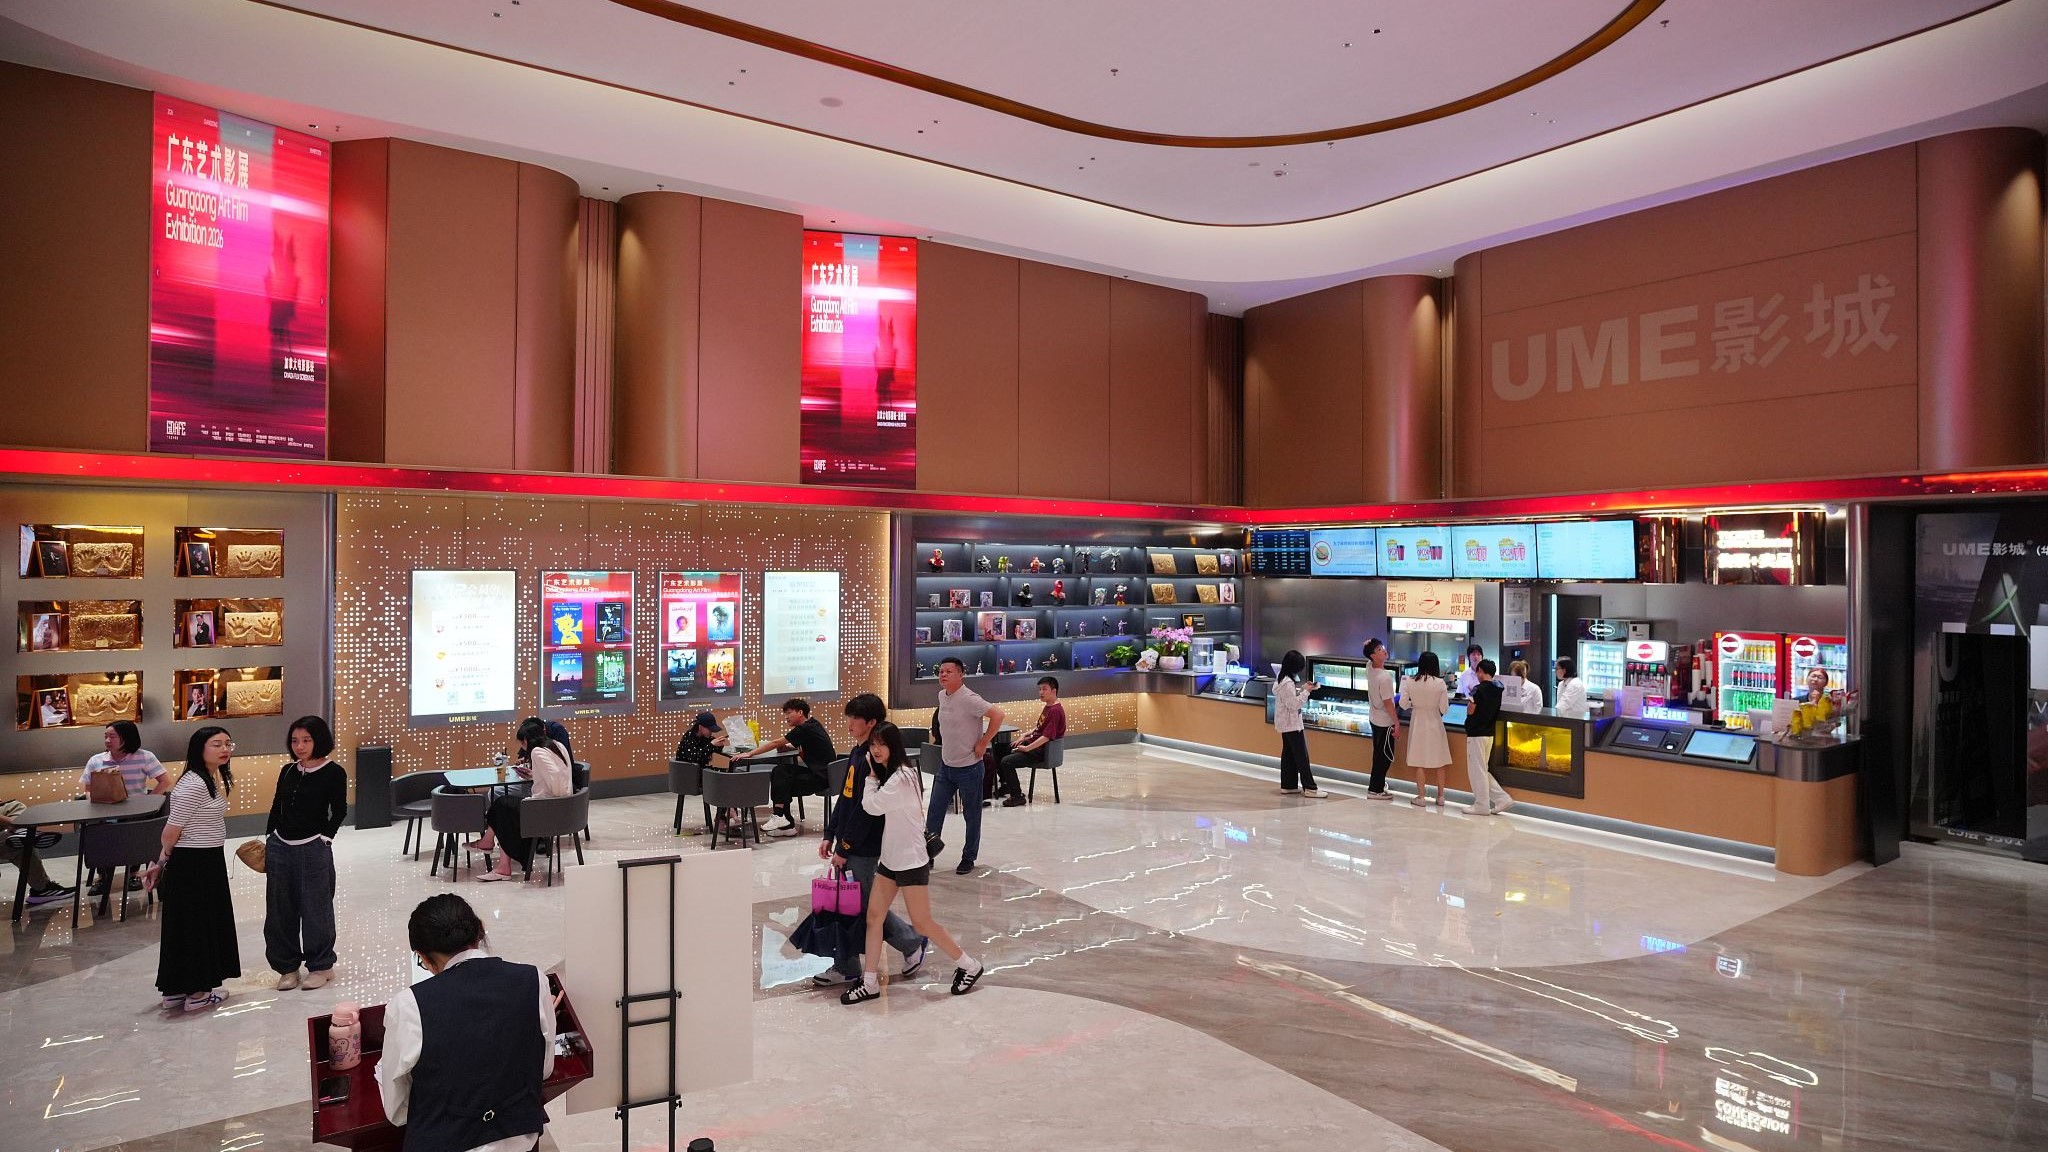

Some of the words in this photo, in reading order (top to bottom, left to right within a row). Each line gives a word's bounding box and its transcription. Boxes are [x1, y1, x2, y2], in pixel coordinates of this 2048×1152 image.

[167, 133, 249, 190] 广东艺术影展
[166, 180, 217, 221] Guangdong
[218, 192, 231, 218] Art
[232, 198, 249, 222] Film
[166, 213, 207, 247] Exhibition
[208, 228, 224, 249] 2026
[811, 262, 859, 288] 广东艺术影展
[1492, 273, 1899, 402] UME影城
[1943, 542, 2026, 556] UME影城
[1388, 603, 1407, 613] 热饮
[1451, 593, 1473, 604] 咖啡
[1450, 605, 1473, 616] 奶茶
[1406, 622, 1424, 630] POP
[1427, 622, 1453, 631] CORN
